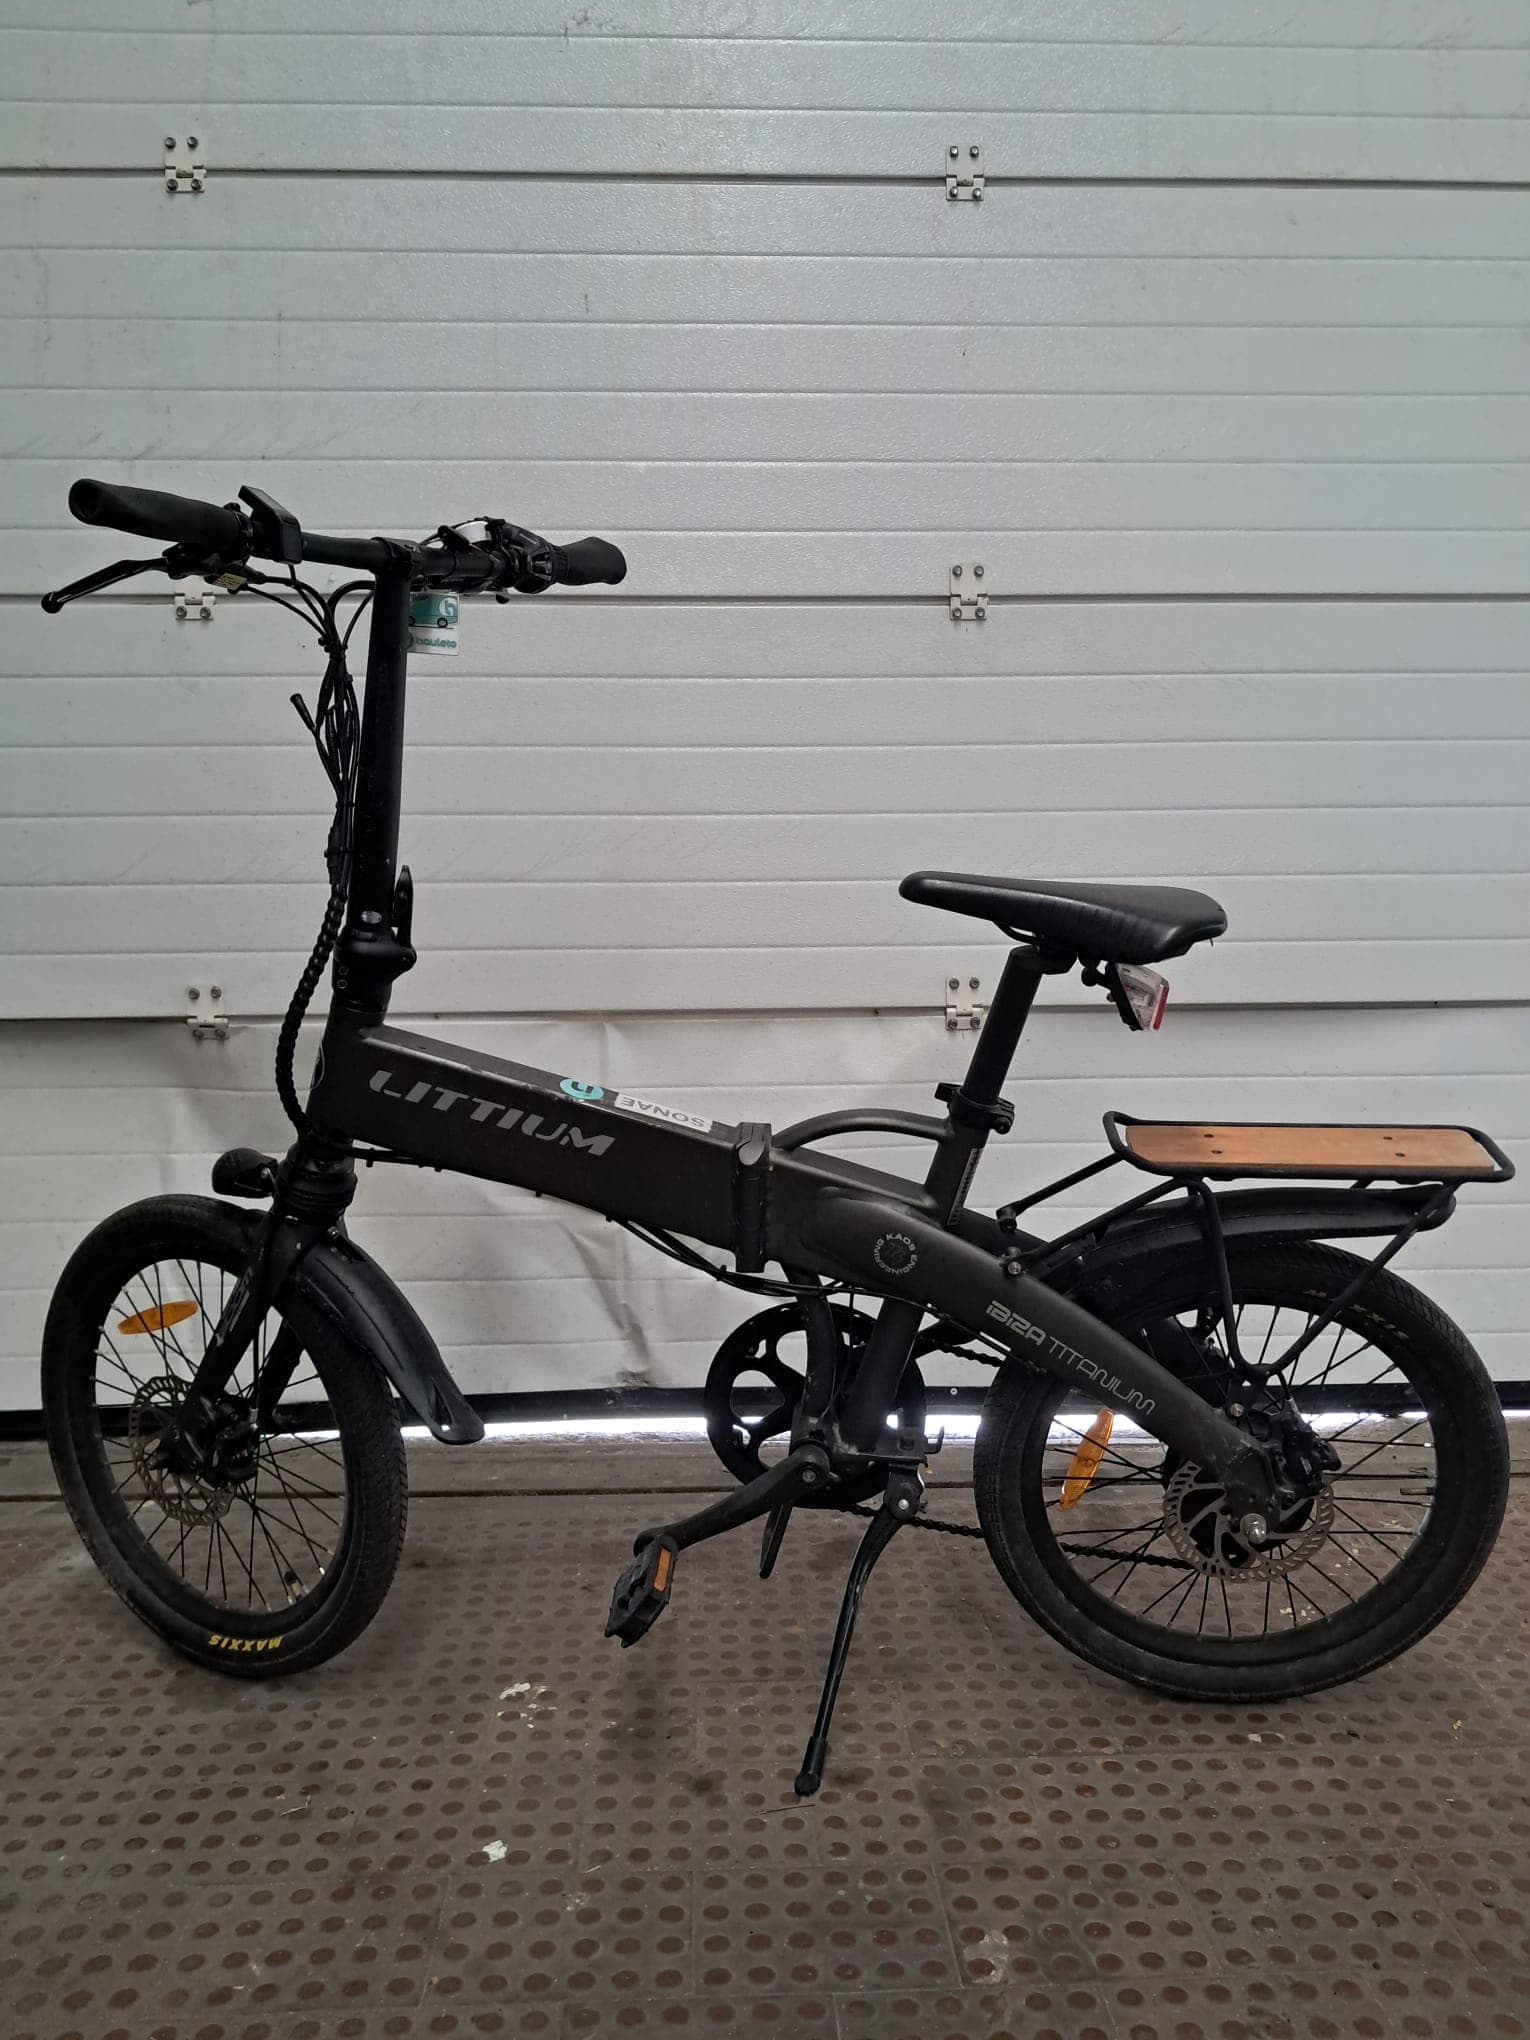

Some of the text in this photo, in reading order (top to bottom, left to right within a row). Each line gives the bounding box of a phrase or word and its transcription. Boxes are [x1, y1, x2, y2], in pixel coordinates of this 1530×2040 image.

[369, 1070, 617, 1157] LITTIUM
[621, 1096, 705, 1128] SONAE
[873, 1233, 918, 1275] KAOS ENGINEERING
[1049, 1335, 1156, 1416] TITANIUM
[208, 1634, 283, 1652] MAXXIS
